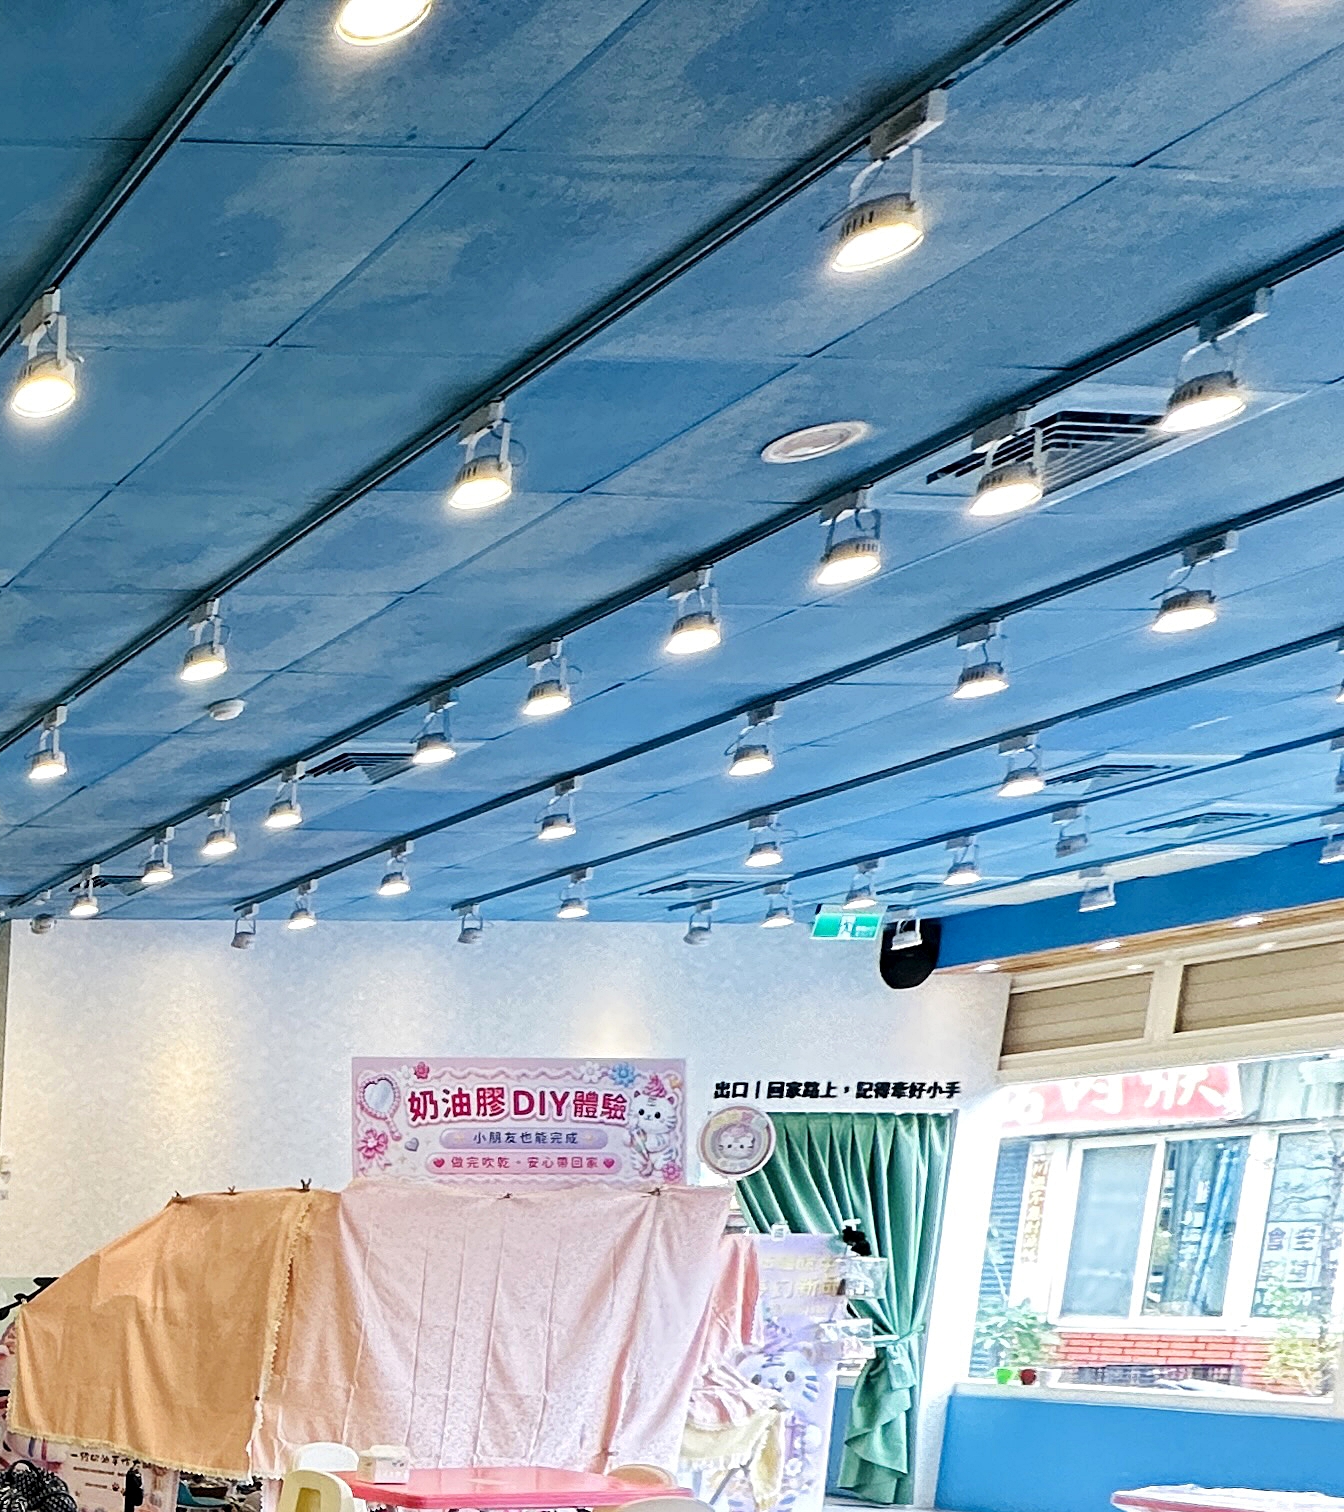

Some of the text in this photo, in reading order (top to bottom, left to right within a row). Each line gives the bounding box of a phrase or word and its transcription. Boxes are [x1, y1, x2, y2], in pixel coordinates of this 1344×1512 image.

[408, 1087, 628, 1121] 奶油膠DIY體驗
[473, 1132, 579, 1144] 小朋友也能完成
